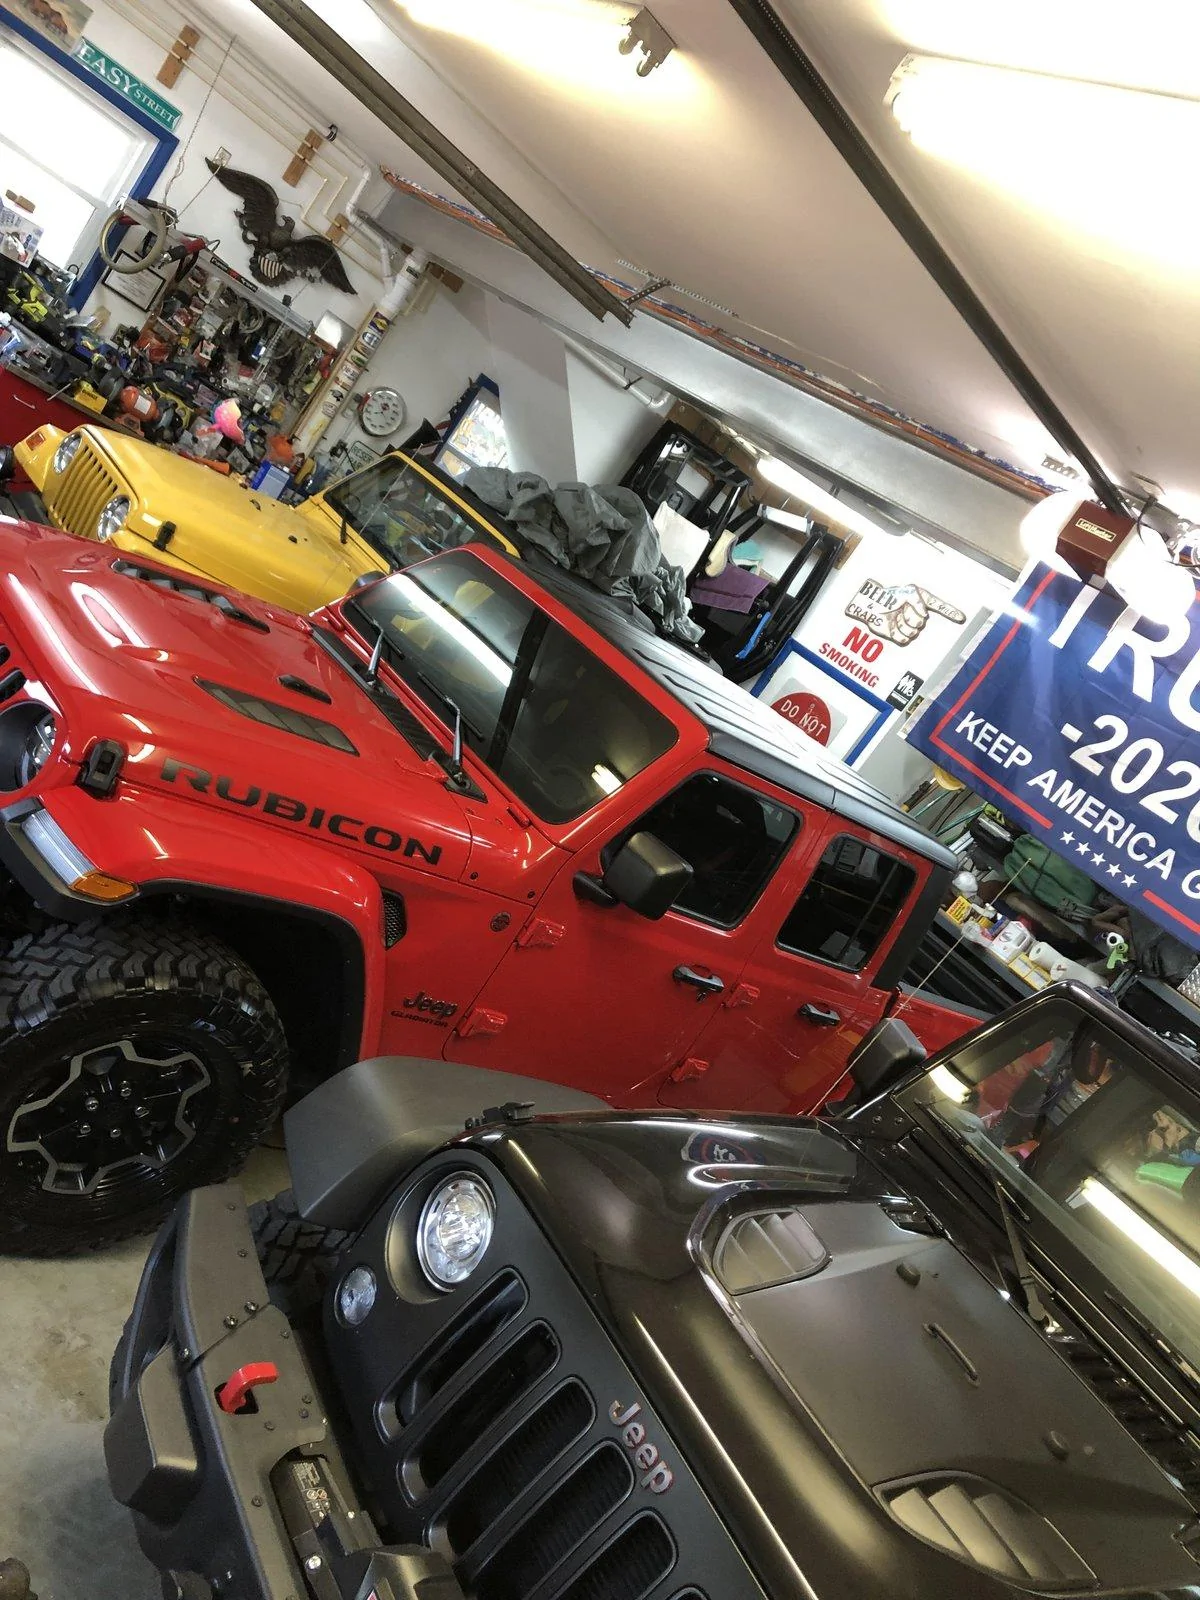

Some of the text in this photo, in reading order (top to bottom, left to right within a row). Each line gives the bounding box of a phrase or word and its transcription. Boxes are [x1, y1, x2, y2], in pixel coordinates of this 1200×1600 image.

[77, 41, 176, 122] EASY STREET
[847, 603, 883, 626] CRABS
[859, 581, 897, 610] BEER
[842, 626, 884, 663] NO
[818, 643, 880, 688] SMOKING
[780, 700, 827, 737] DO NOT
[160, 757, 443, 866] RUBICON
[955, 711, 1033, 770] KEEP
[1027, 769, 1177, 880] AMERICA
[403, 991, 458, 1020] Jeep
[608, 1399, 674, 1494] Jeep
